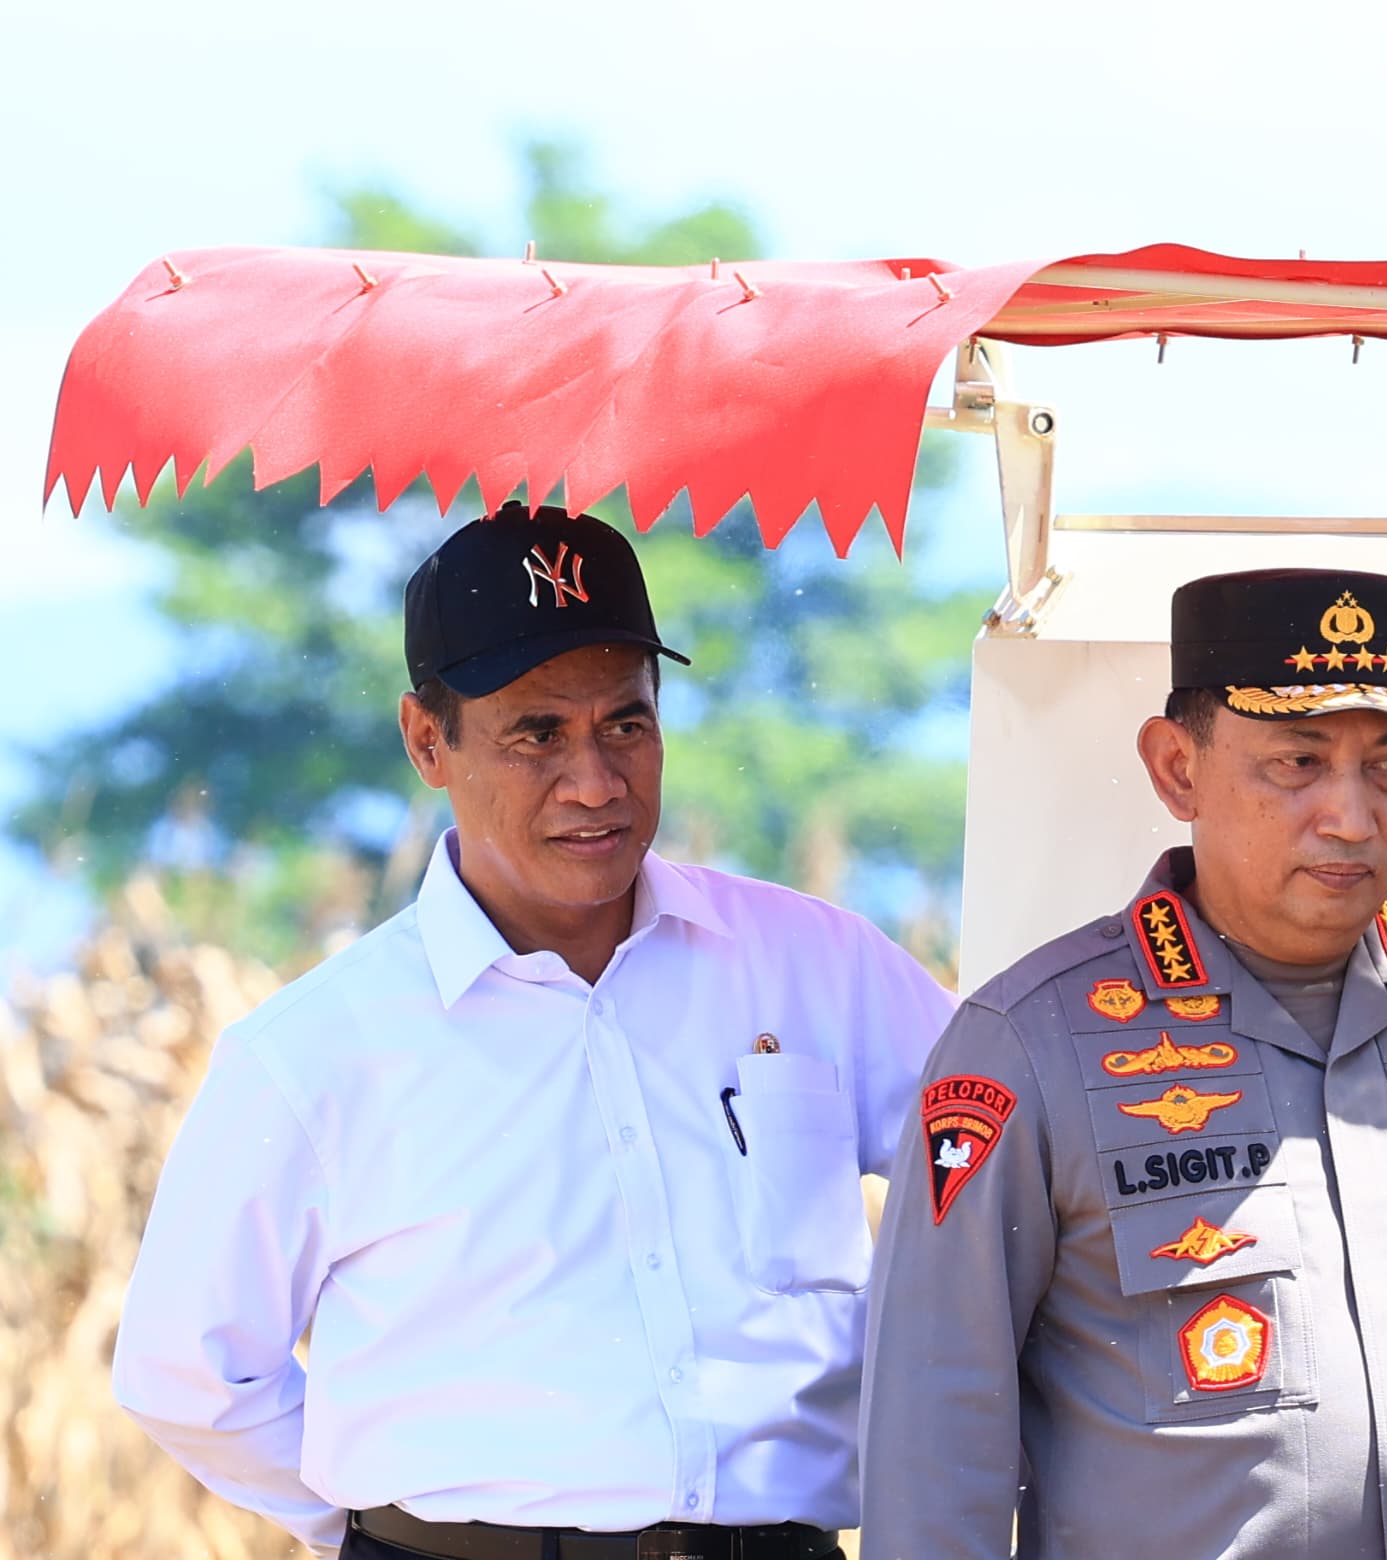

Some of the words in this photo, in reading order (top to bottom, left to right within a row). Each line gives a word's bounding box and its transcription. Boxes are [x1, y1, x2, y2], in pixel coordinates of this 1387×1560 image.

[522, 542, 590, 608] NY
[927, 1081, 1006, 1113] PELOPOR
[929, 1116, 959, 1134] KORPS
[961, 1116, 995, 1140] BRIMOB
[1113, 1142, 1271, 1196] L.SIGIT.P
